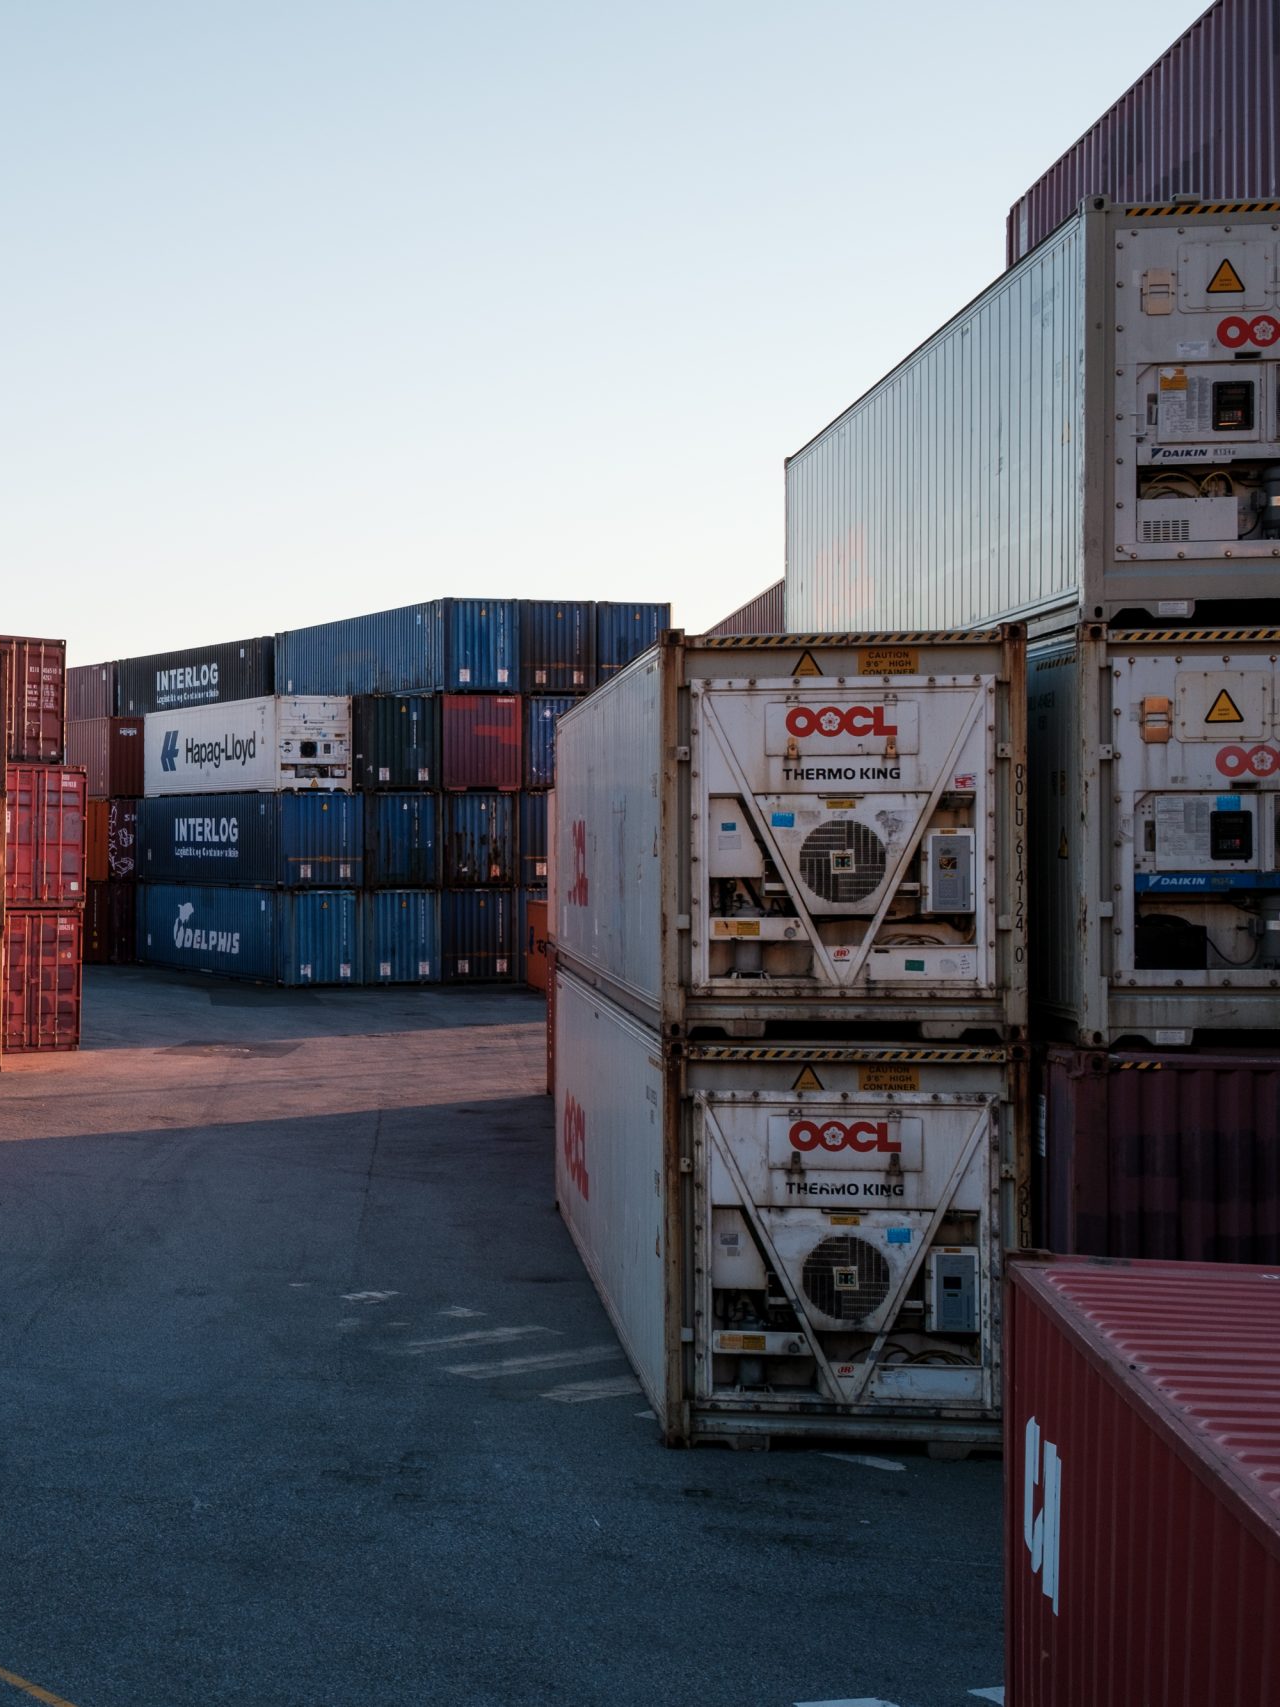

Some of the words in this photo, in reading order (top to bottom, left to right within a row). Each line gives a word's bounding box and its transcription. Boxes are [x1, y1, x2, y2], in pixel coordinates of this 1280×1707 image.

[1162, 449, 1208, 457] DAIKIN
[868, 651, 909, 659] CAUTION
[156, 663, 219, 691] INTERLOG
[786, 706, 897, 737] OOCL
[185, 730, 256, 769] Hapag-Lloyd
[783, 768, 856, 780] THERMO
[860, 768, 901, 780] KING
[1015, 763, 1024, 826] OOLU
[175, 817, 239, 843] INTERLOG
[1015, 839, 1024, 932] 614124
[1160, 877, 1207, 885] DAIKIN
[868, 1065, 911, 1074] CAUTION
[863, 1083, 916, 1091] CONTAINER
[789, 1121, 902, 1152] OOCL
[786, 1182, 859, 1196] THERMO
[863, 1184, 904, 1197] KING
